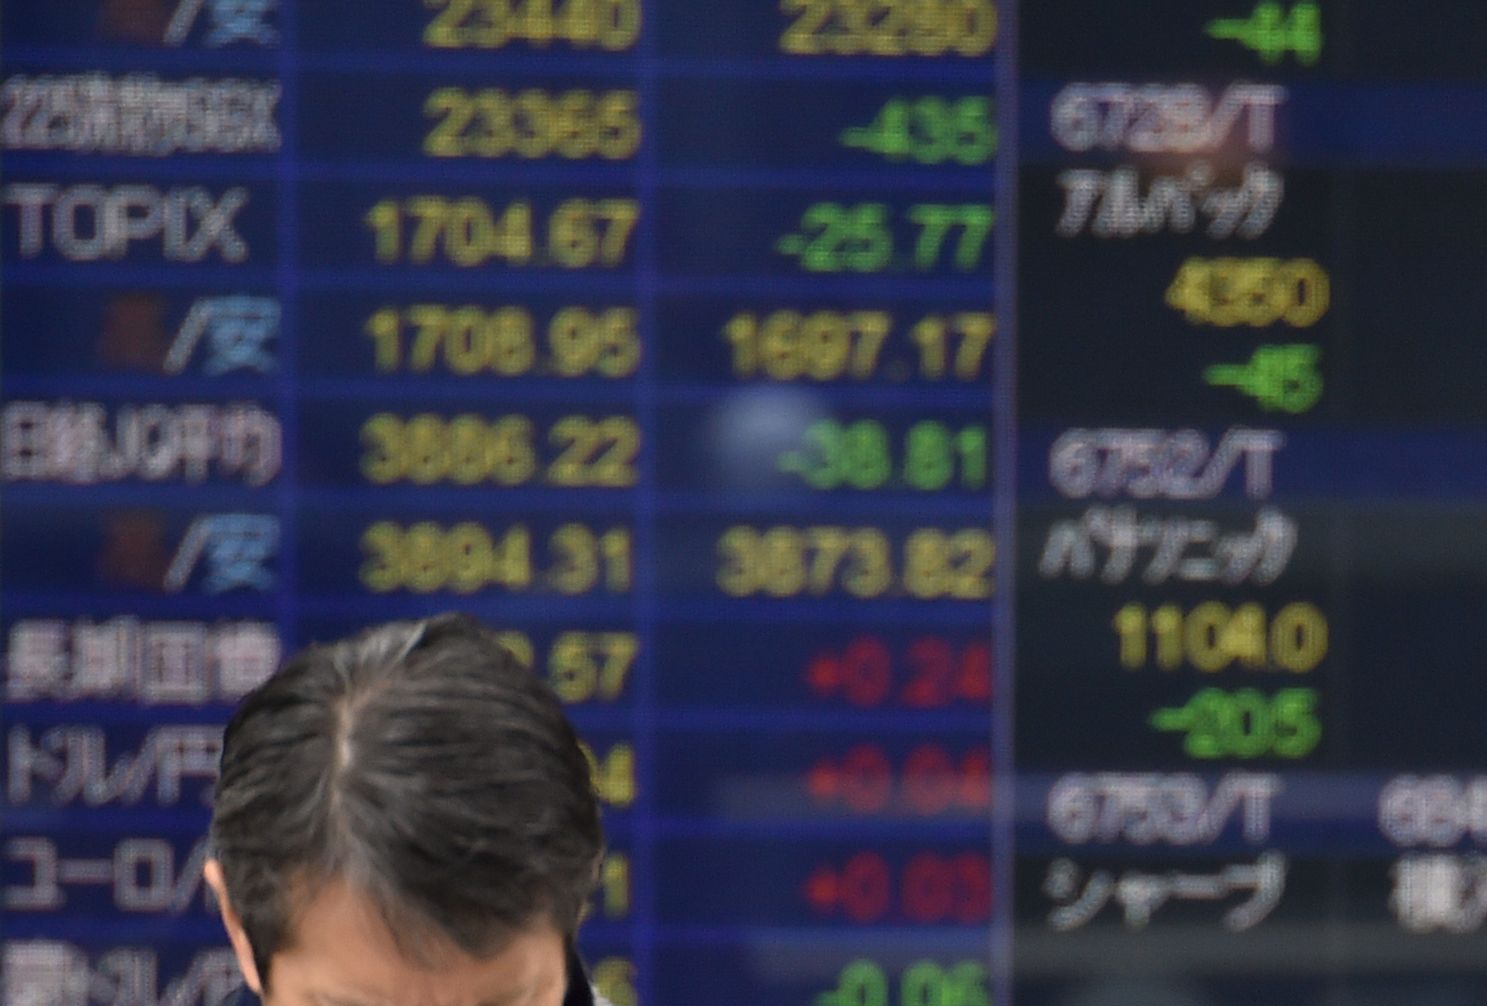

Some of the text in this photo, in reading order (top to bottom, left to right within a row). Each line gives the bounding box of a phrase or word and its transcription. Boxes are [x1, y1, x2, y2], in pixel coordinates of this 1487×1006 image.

[6, 184, 247, 262] TOPIX
[1050, 428, 1281, 500] 6752/T
[1045, 772, 1284, 843] 6753/T
